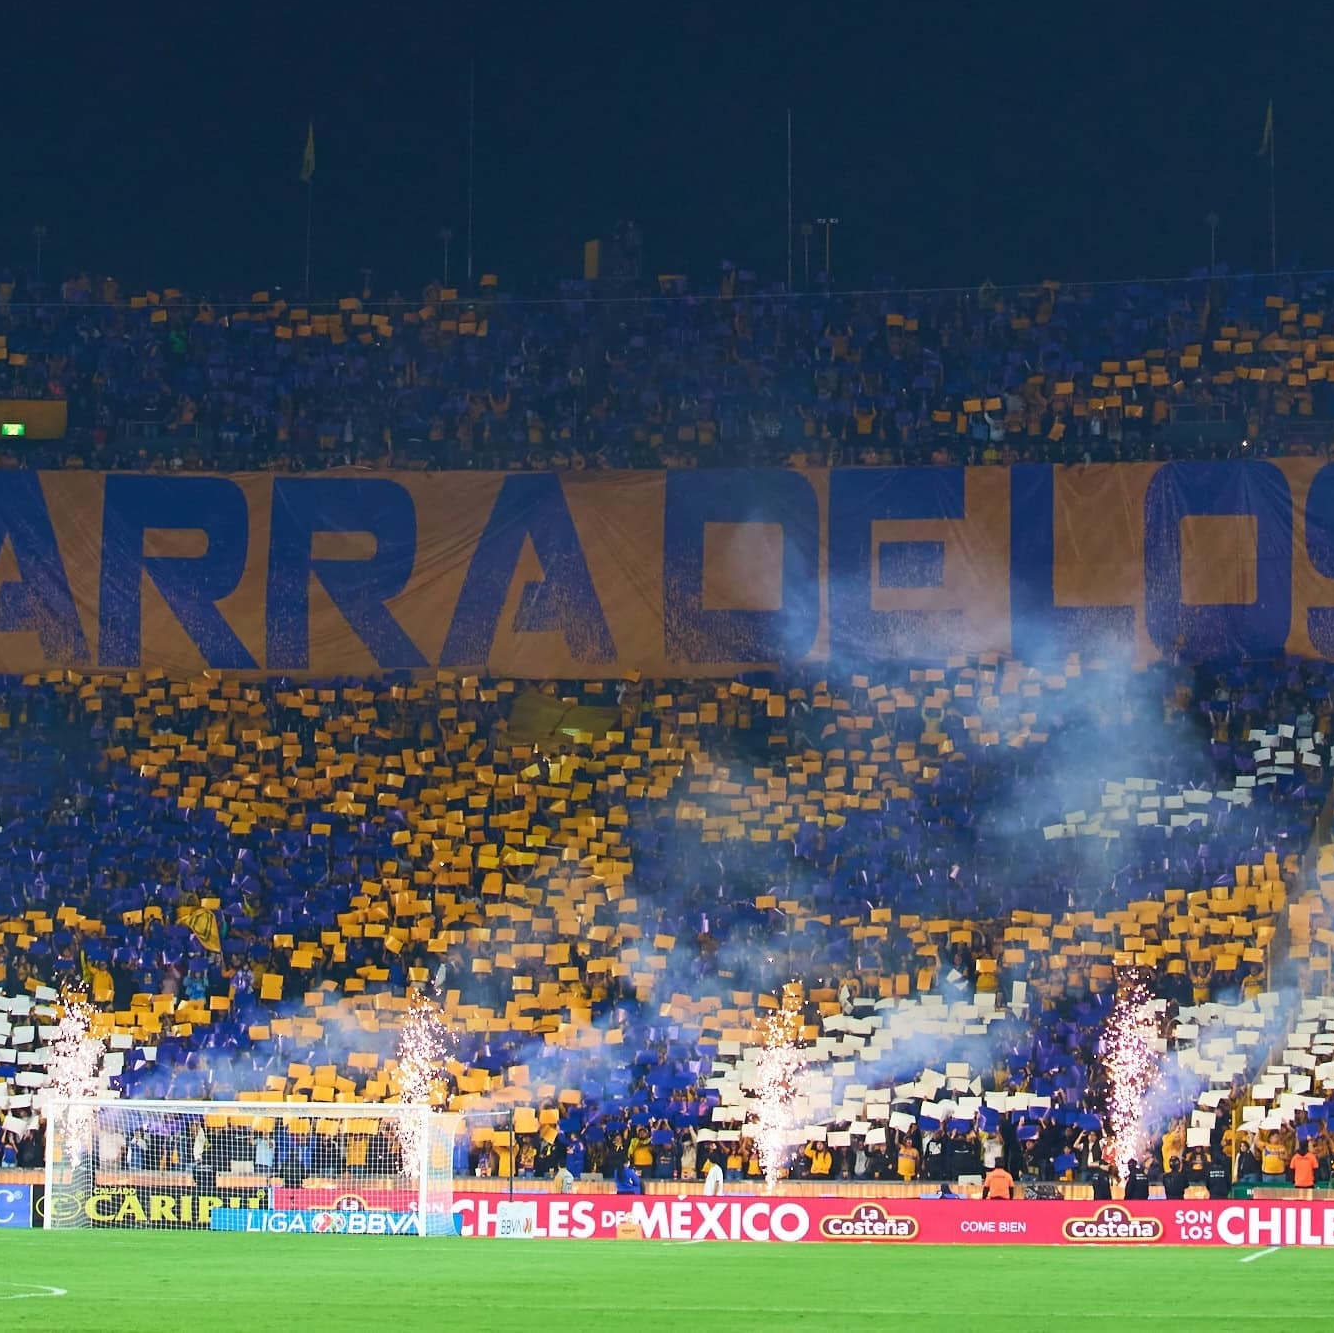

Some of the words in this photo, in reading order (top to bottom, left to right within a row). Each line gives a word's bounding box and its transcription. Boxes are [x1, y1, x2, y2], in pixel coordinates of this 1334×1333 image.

[664, 466, 966, 664] DE
[93, 1187, 136, 1196] CALZADO
[629, 1195, 810, 1242] MÉXICO
[860, 1207, 879, 1220] La
[1104, 1209, 1122, 1222] La
[1175, 1210, 1213, 1224] SON
[247, 1213, 307, 1233] LIGA
[348, 1213, 421, 1234] BBVA
[828, 1218, 909, 1236] Costeña
[960, 1221, 996, 1233] COME
[999, 1222, 1027, 1233] BIEN
[1071, 1220, 1154, 1237] Costeña
[1180, 1226, 1213, 1240] LOS
